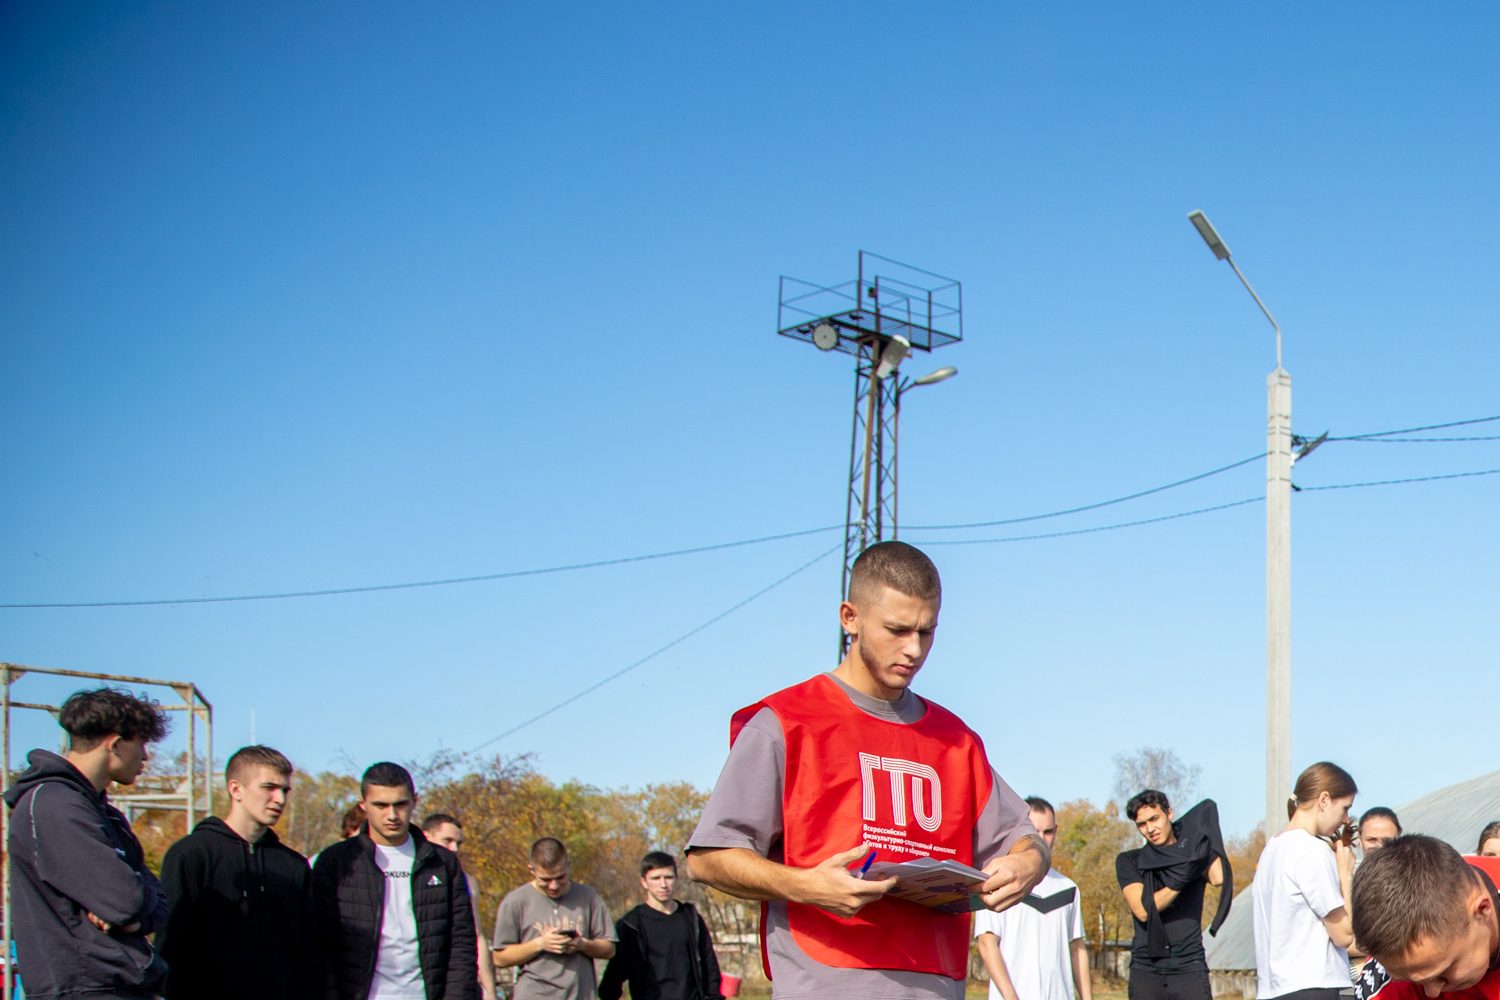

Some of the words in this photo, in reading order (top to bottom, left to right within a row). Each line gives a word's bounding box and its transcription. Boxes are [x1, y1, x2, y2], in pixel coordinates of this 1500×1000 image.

[859, 752, 942, 832] ГТО
[862, 823, 907, 837] Всероссийский
[862, 832, 933, 850] физкультурно-спортивный
[932, 846, 957, 855] комплекс
[888, 844, 905, 854] труду
